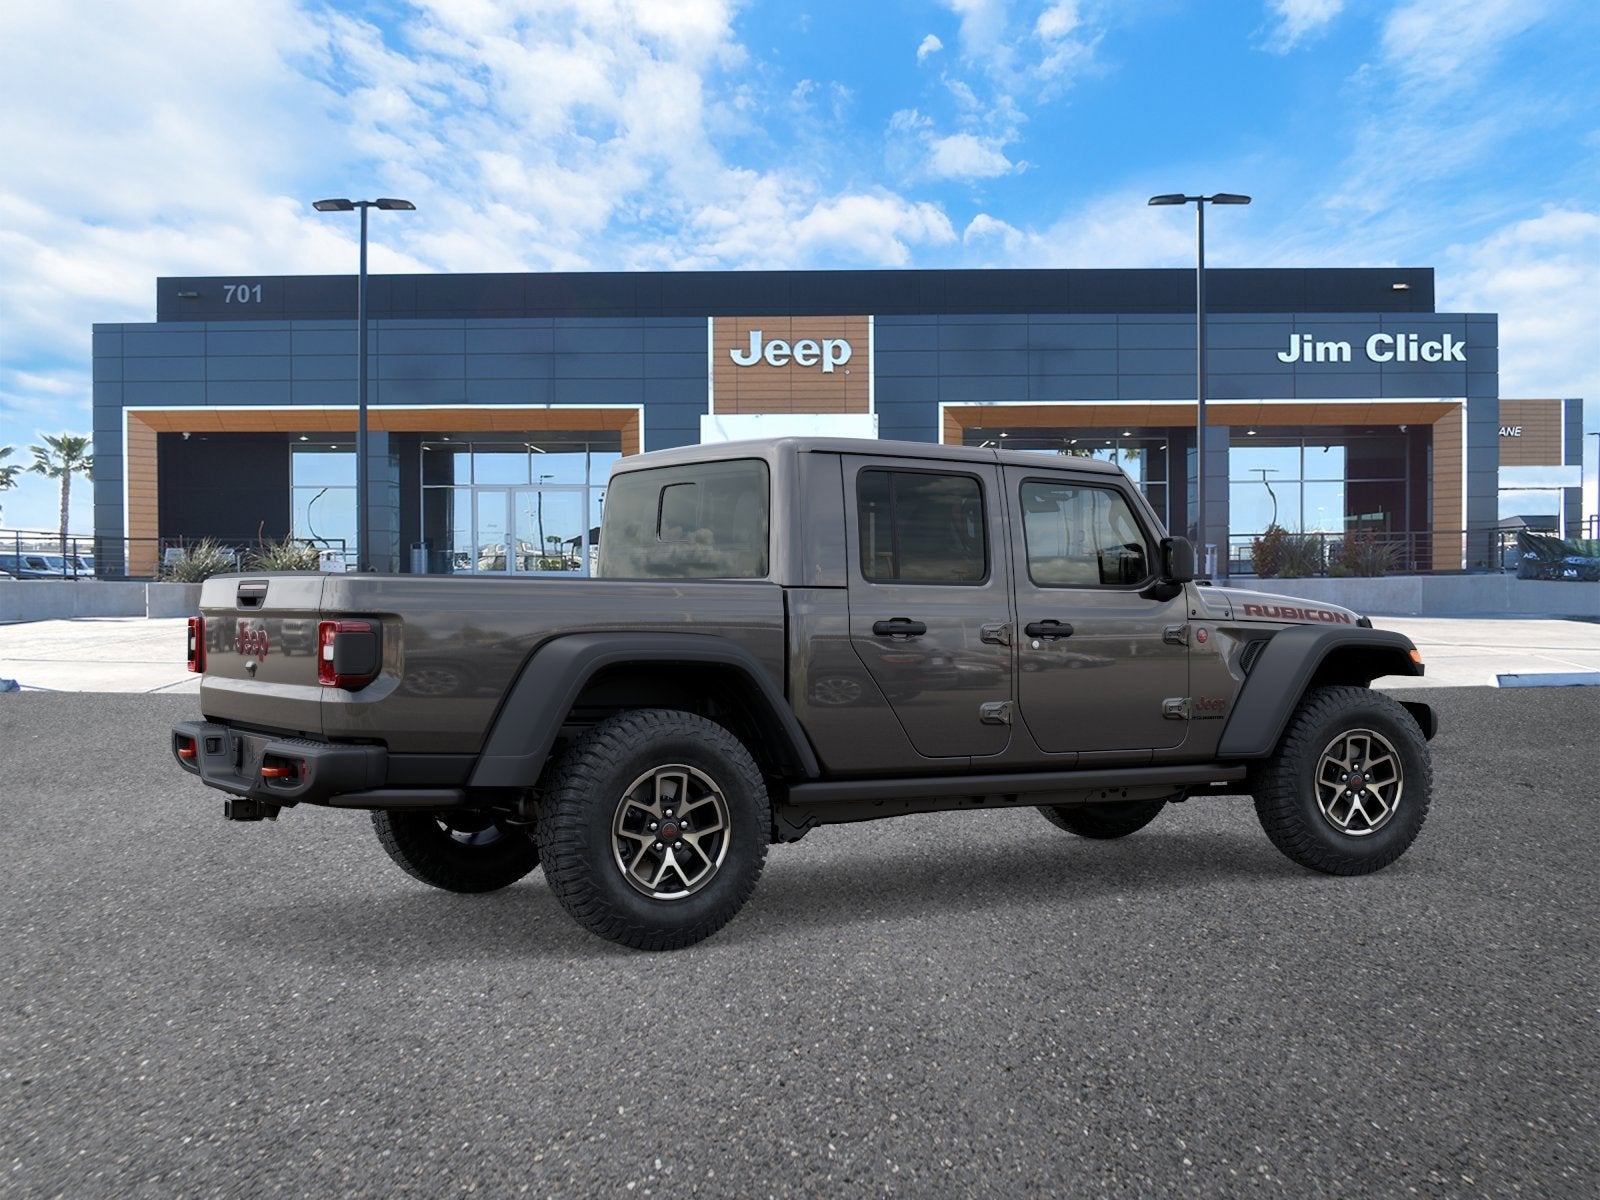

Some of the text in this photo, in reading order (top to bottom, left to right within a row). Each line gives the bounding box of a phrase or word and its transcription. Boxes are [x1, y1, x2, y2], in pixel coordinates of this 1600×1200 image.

[223, 284, 262, 304] 701
[729, 330, 852, 374] Jeep
[1277, 333, 1467, 363] Jim Click
[1243, 603, 1351, 625] RUBICON
[234, 621, 269, 663] Jeep
[1195, 695, 1226, 713] Jeep
